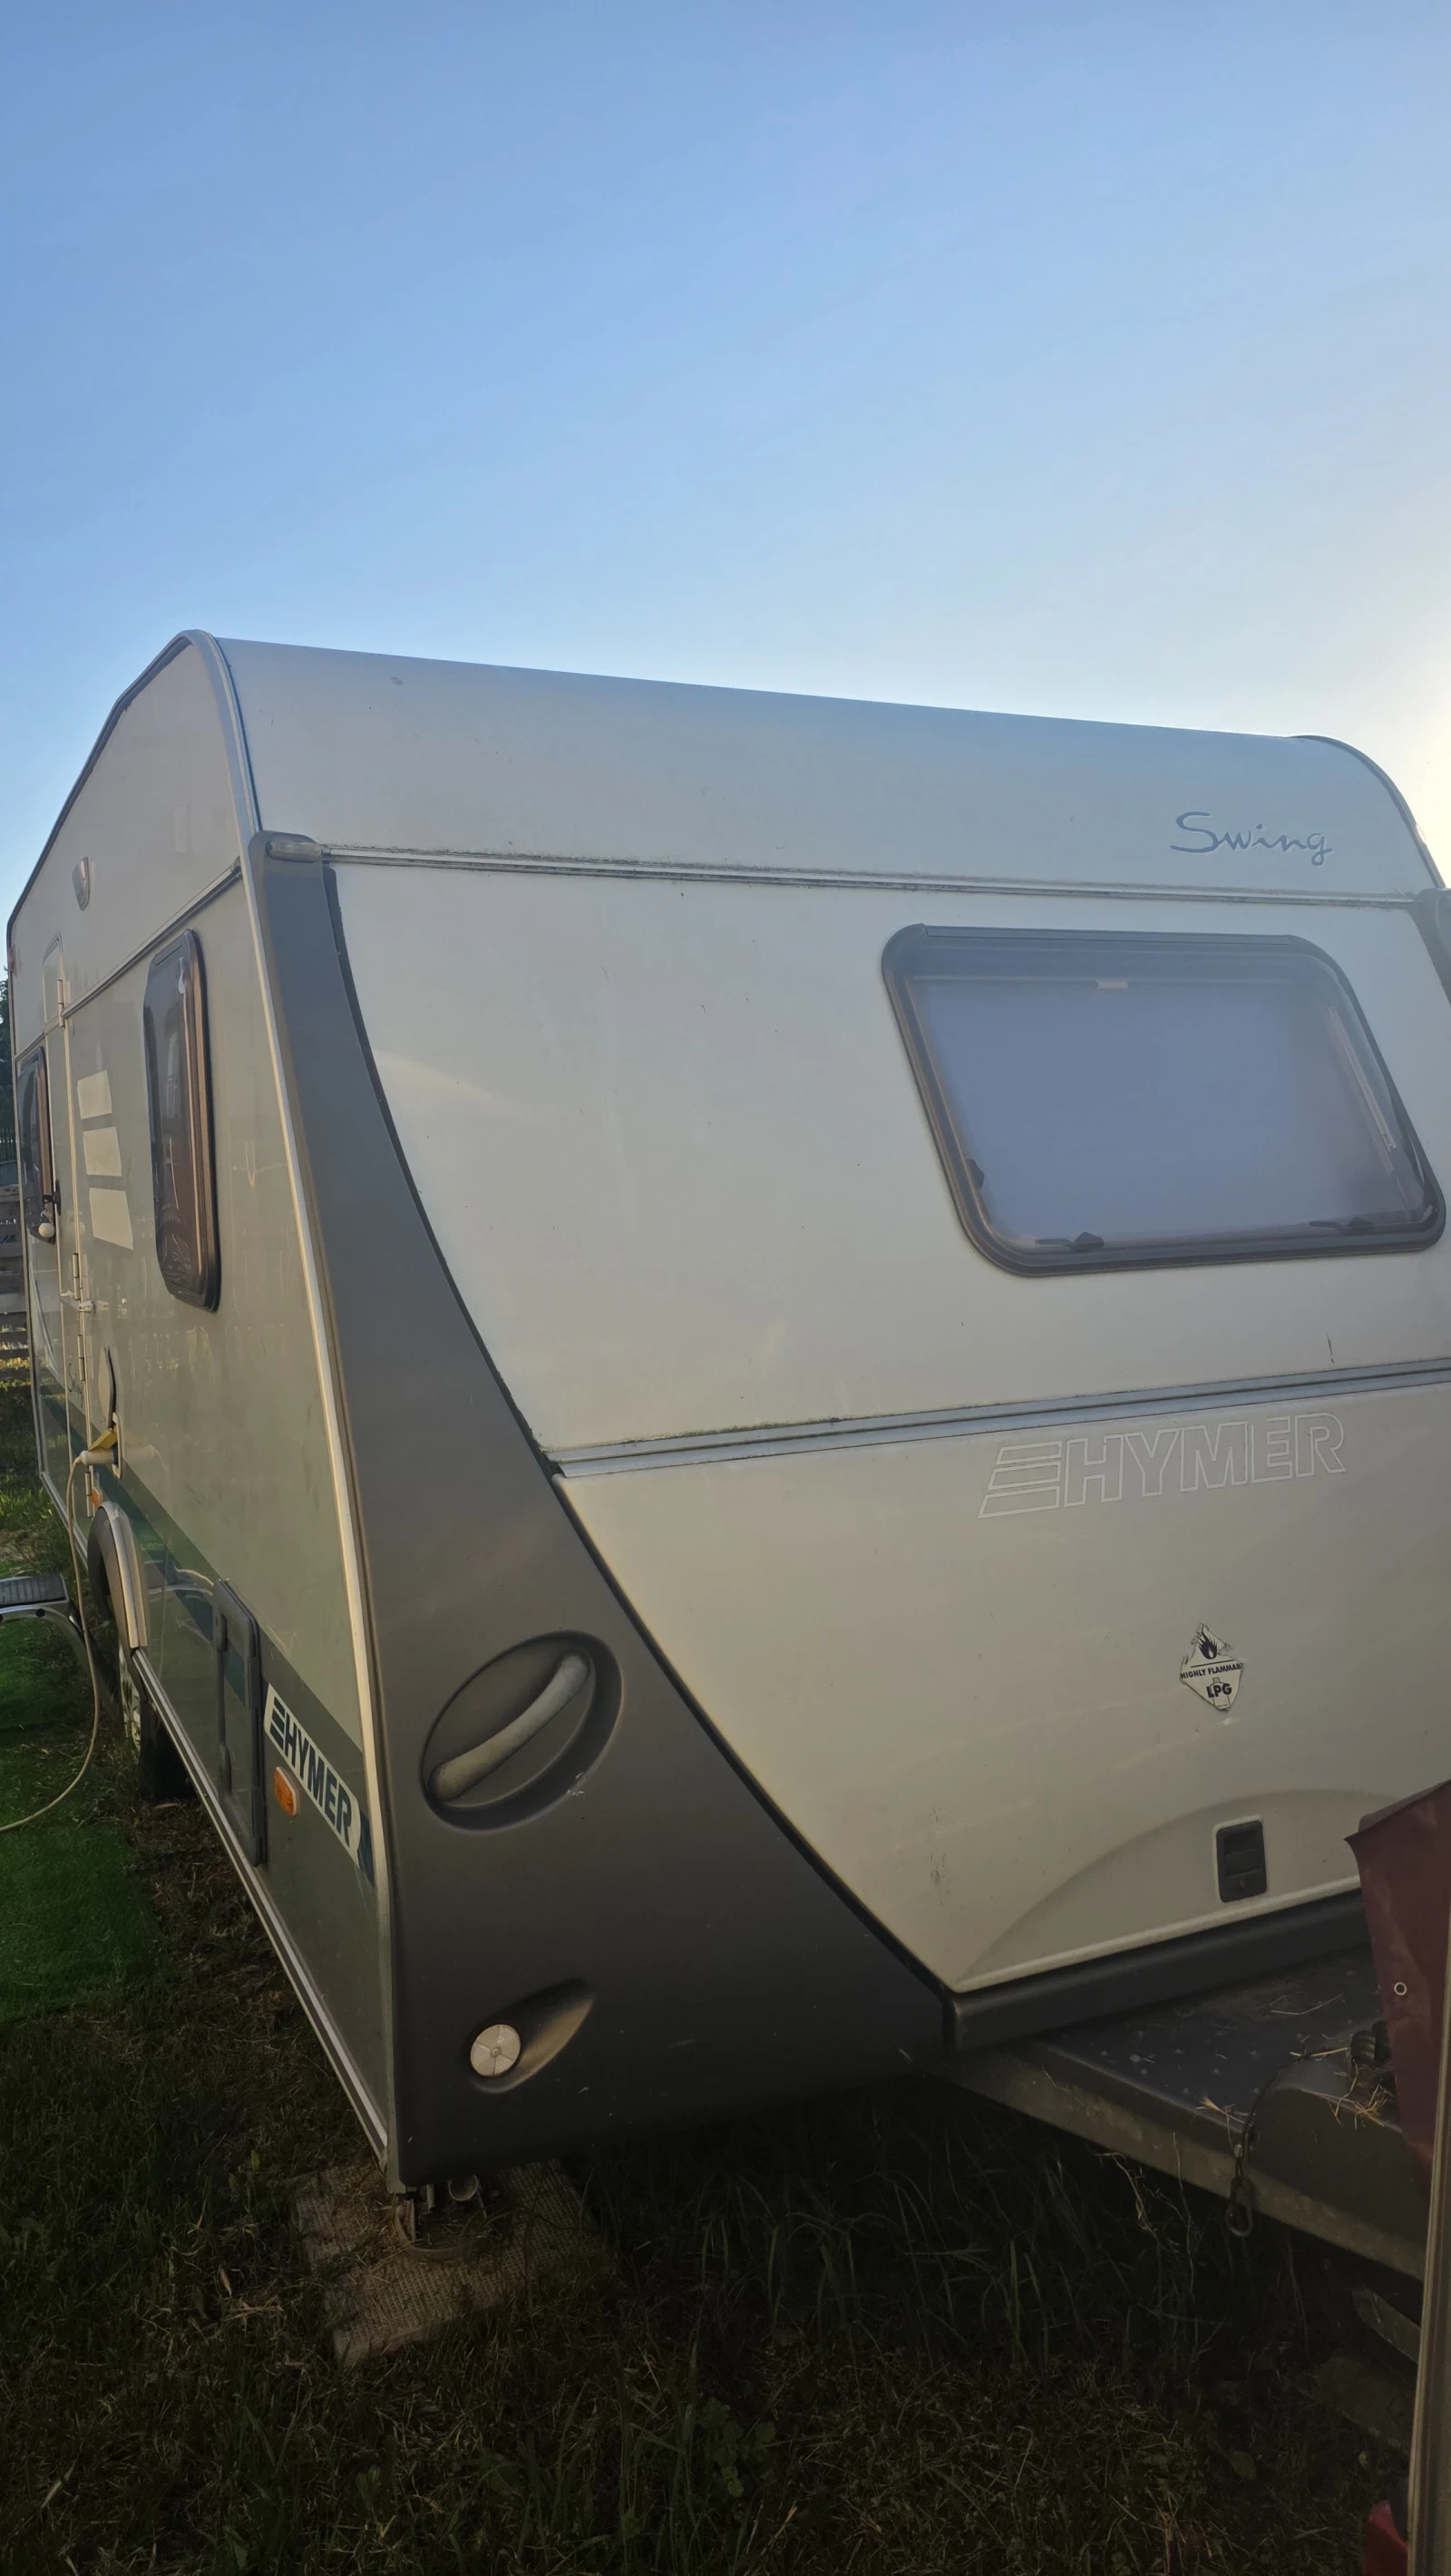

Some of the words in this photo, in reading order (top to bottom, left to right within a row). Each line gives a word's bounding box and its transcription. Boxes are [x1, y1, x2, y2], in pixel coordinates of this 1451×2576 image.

[1170, 811, 1333, 866] Swing
[1063, 1412, 1347, 1508] HYMER
[1180, 1668, 1207, 1679] HIGHLY
[1206, 1683, 1232, 1698] LPG
[285, 1711, 353, 1849] HYMER
